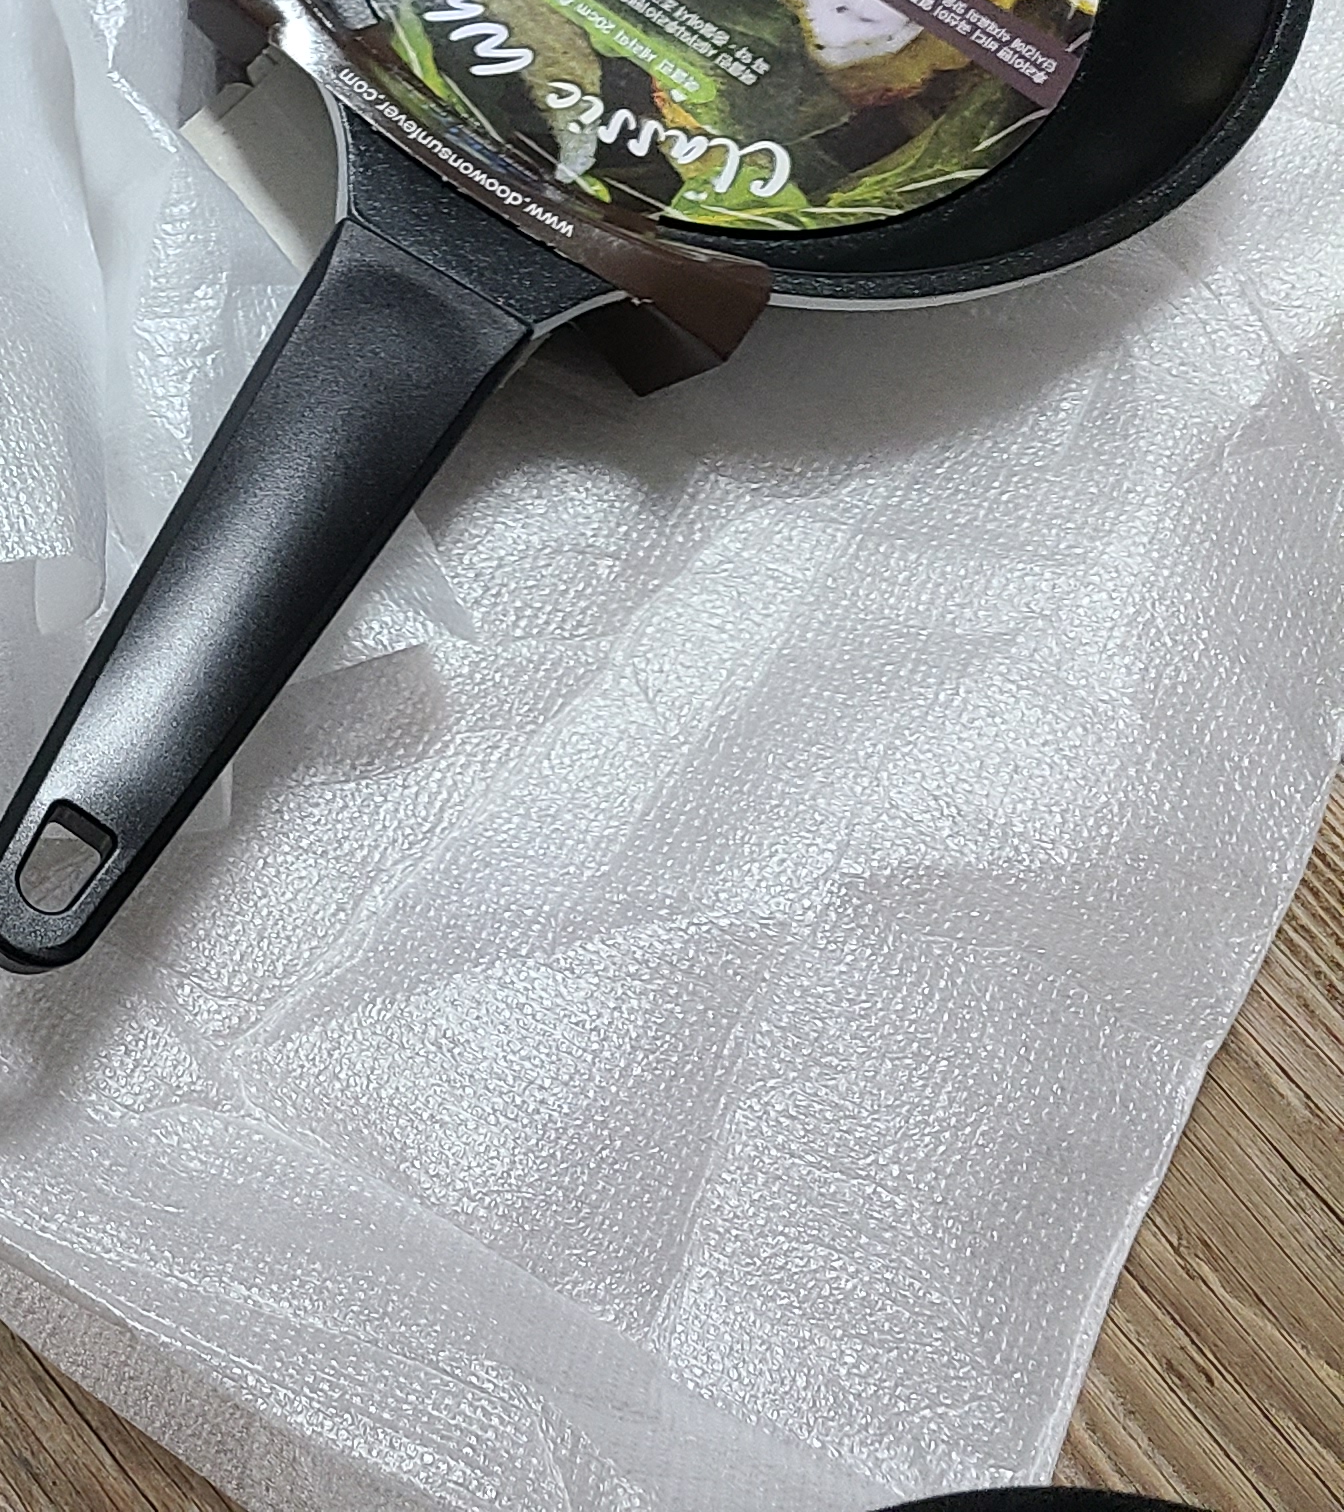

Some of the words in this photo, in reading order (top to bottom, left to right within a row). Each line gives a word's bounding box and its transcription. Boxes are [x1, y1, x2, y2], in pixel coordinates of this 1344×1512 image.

[571, 0, 617, 37] 20cm
[339, 69, 574, 238] www.doowonsunfever.com
[547, 81, 791, 197] Classic
